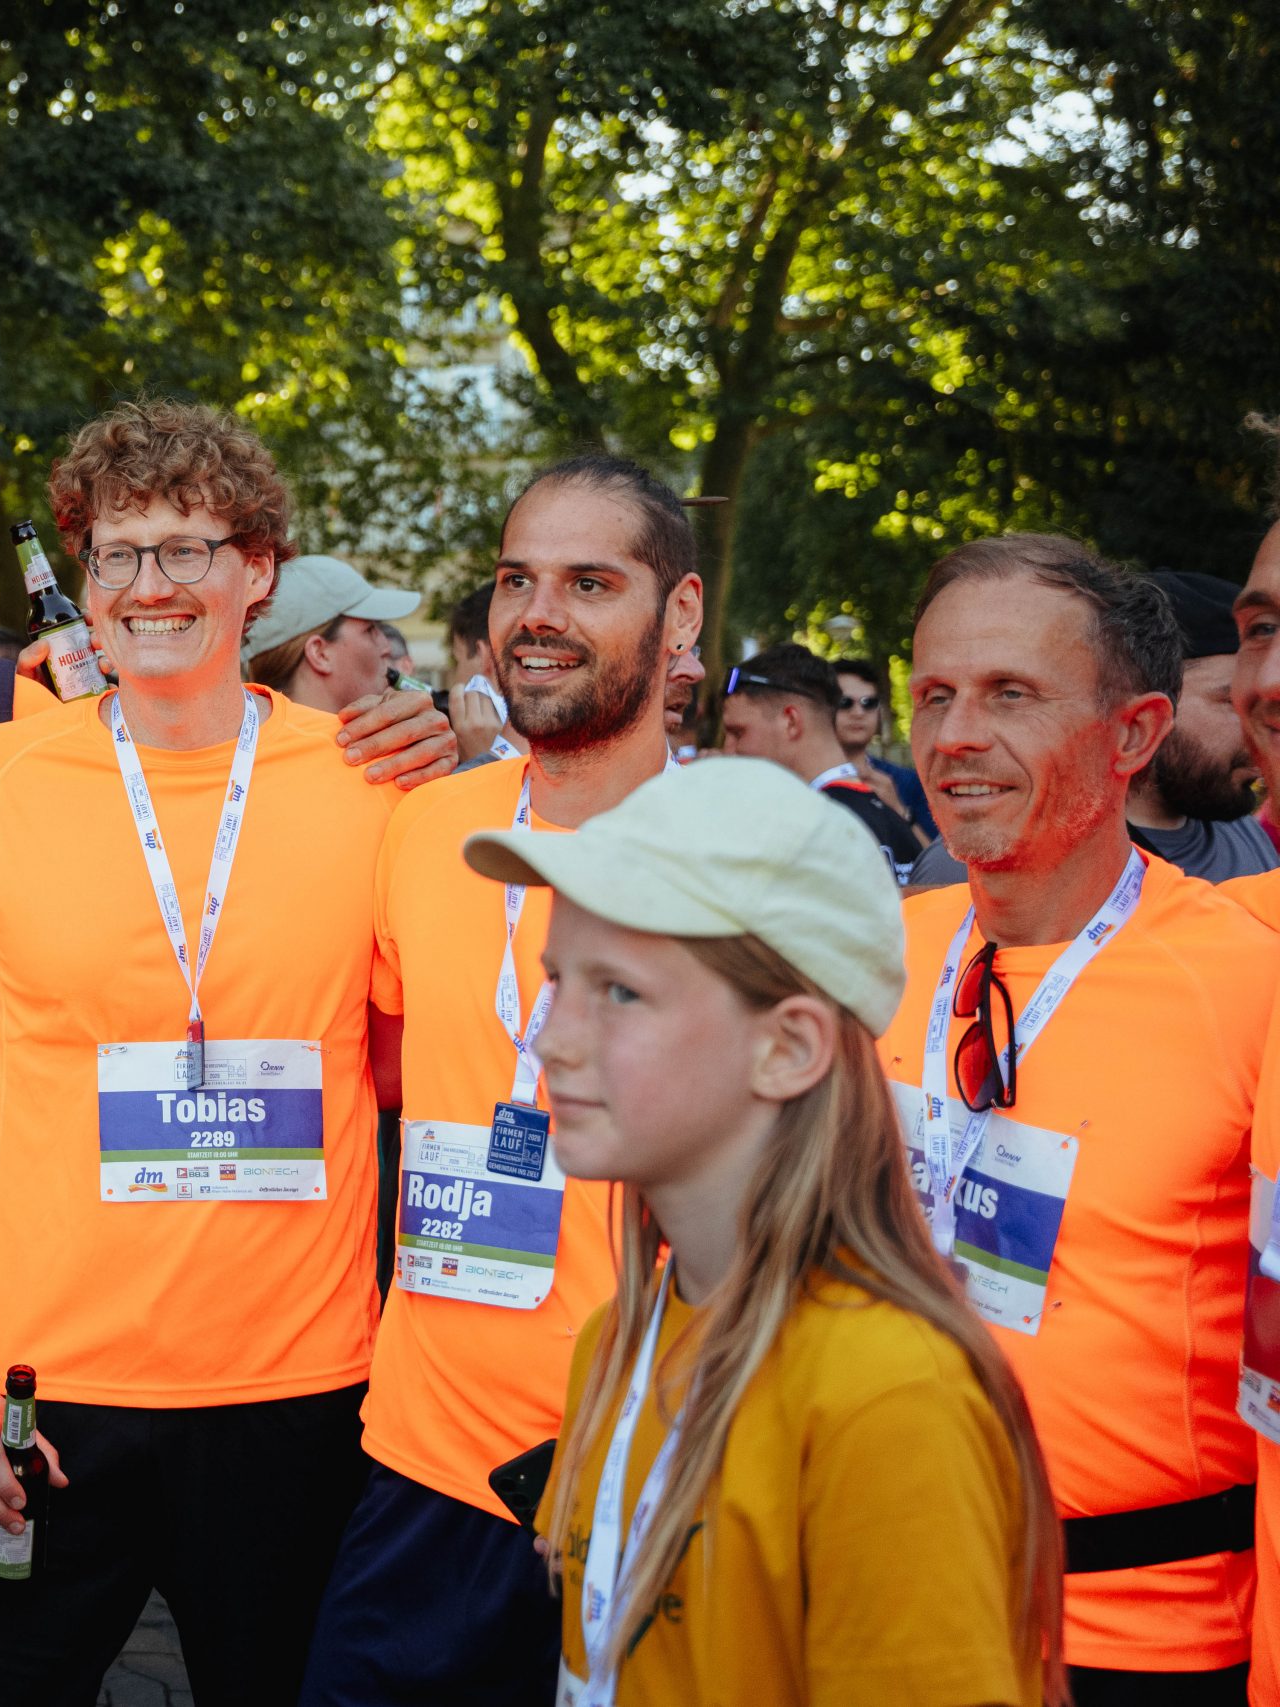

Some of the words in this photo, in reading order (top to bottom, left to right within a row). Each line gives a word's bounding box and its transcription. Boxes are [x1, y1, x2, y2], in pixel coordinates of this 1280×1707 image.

[116, 728, 126, 743] dm
[233, 784, 245, 802] dm
[517, 807, 527, 823] dm
[145, 832, 156, 849] dm
[210, 897, 220, 915] dm
[1087, 921, 1107, 940] dm
[178, 945, 186, 963] dm
[944, 966, 955, 984] dm
[156, 1092, 266, 1123] Tobias
[499, 1108, 514, 1120] dm
[931, 1097, 944, 1119] dm
[190, 1131, 235, 1148] 2289
[495, 1126, 524, 1139] FIRMEN
[422, 1143, 441, 1152] FIRMEN
[494, 1134, 522, 1150] LAUF
[420, 1151, 440, 1162] LAUF
[135, 1167, 163, 1184] dm
[244, 1168, 299, 1176] BIONTECH
[407, 1174, 492, 1221] Rodja
[420, 1218, 463, 1240] 2282
[465, 1265, 523, 1281] BIONTECH
